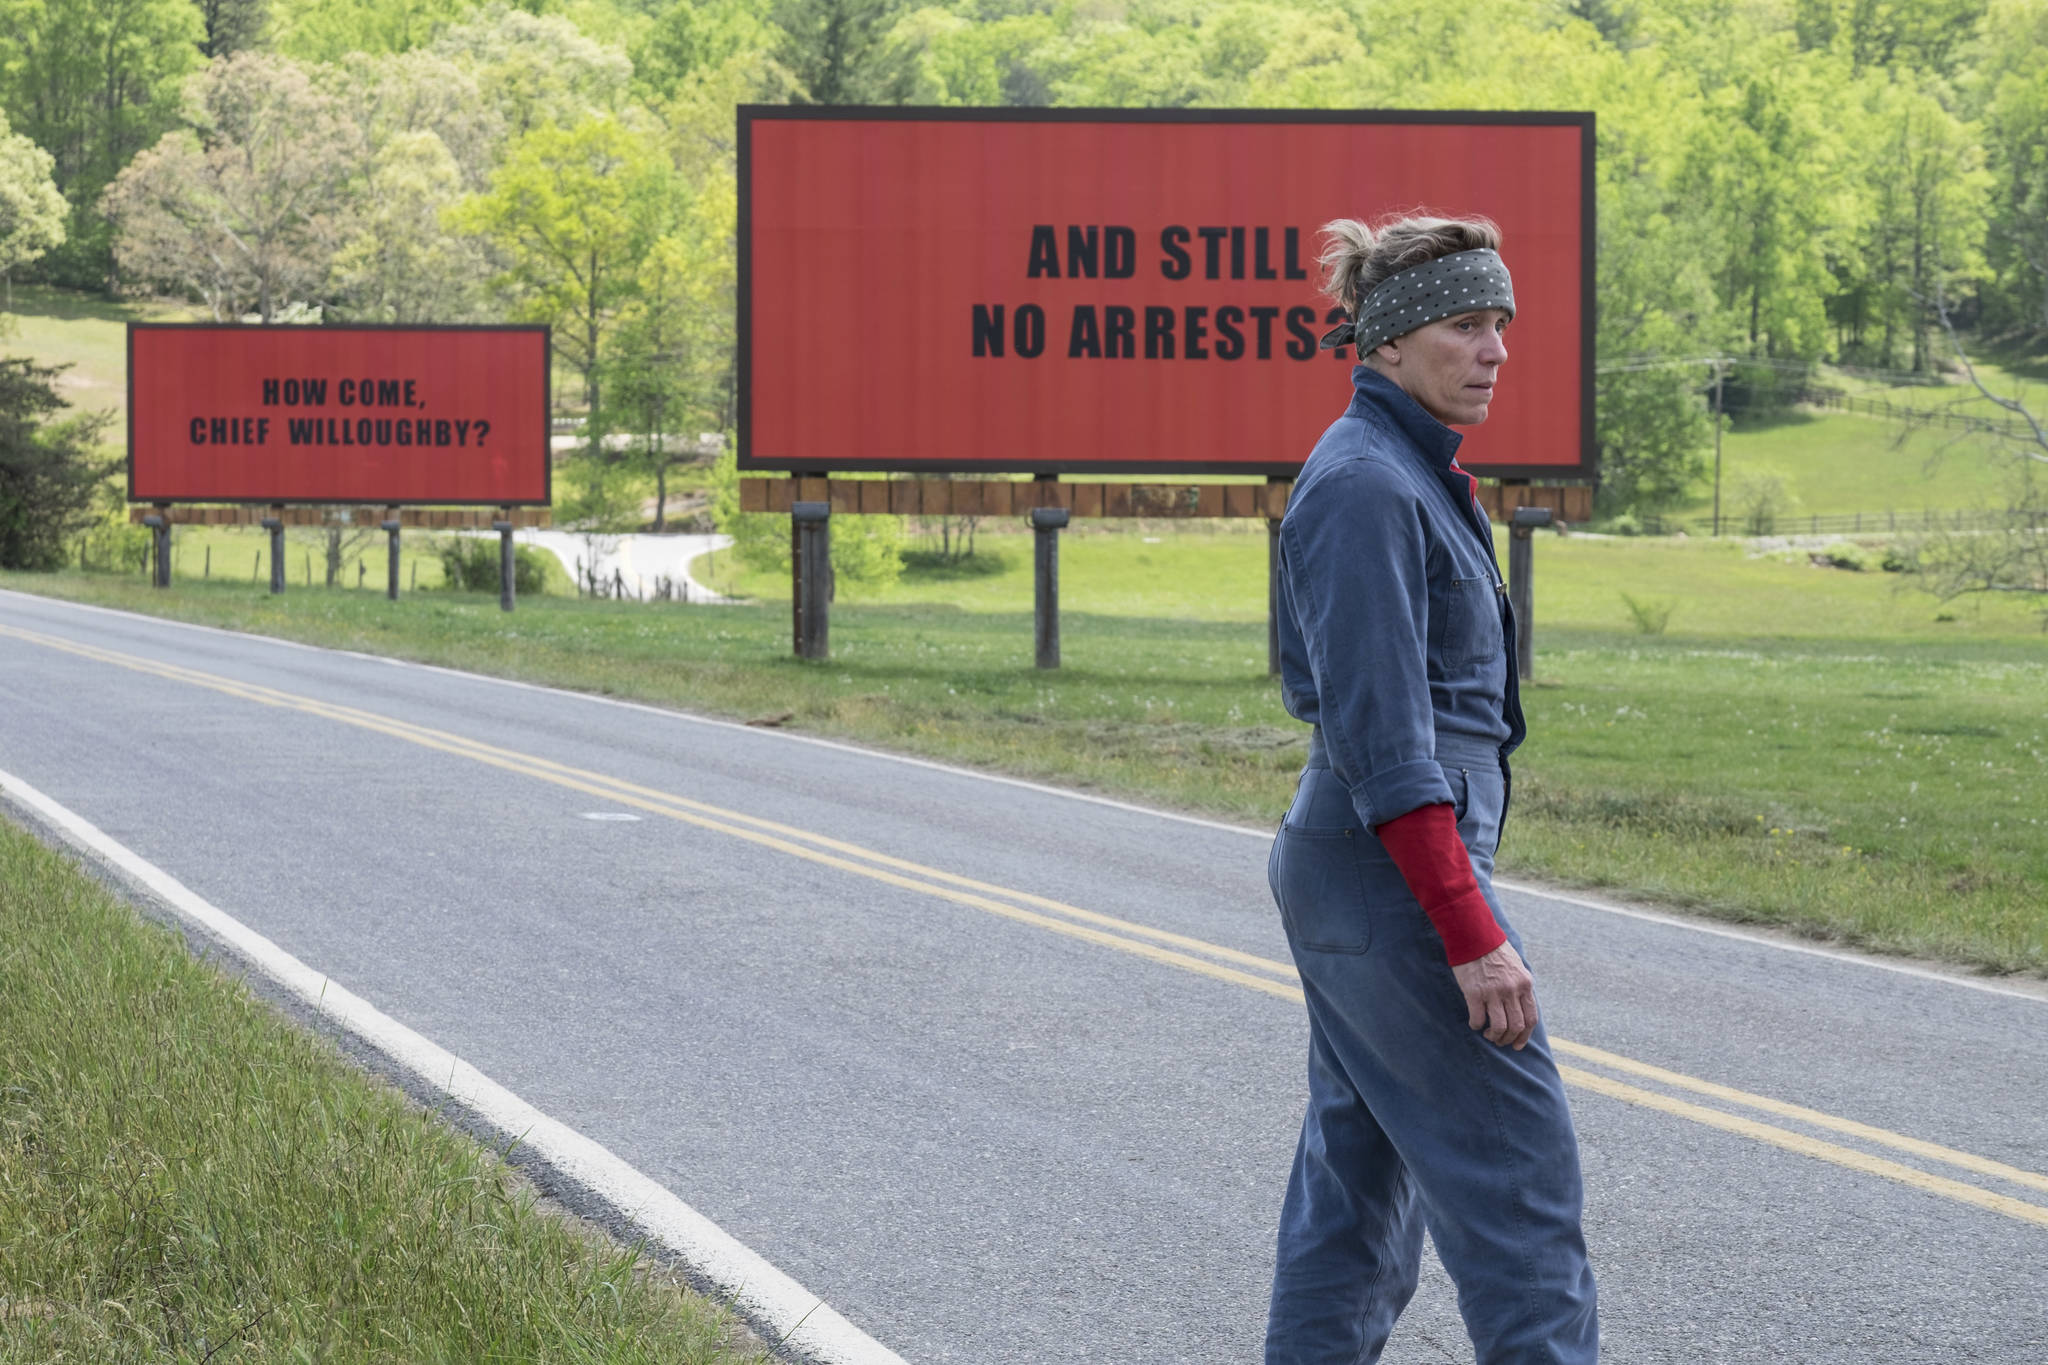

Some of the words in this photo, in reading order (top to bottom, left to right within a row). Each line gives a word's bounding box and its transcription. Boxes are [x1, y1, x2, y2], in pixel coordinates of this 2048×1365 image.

[1026, 225, 1137, 280] AND
[1159, 225, 1308, 281] STILL
[971, 303, 1046, 359] NO
[262, 378, 328, 407] HOW
[338, 378, 426, 410] COME,
[189, 416, 270, 446] CHIEF
[287, 417, 491, 448] WILLOUGHBY?
